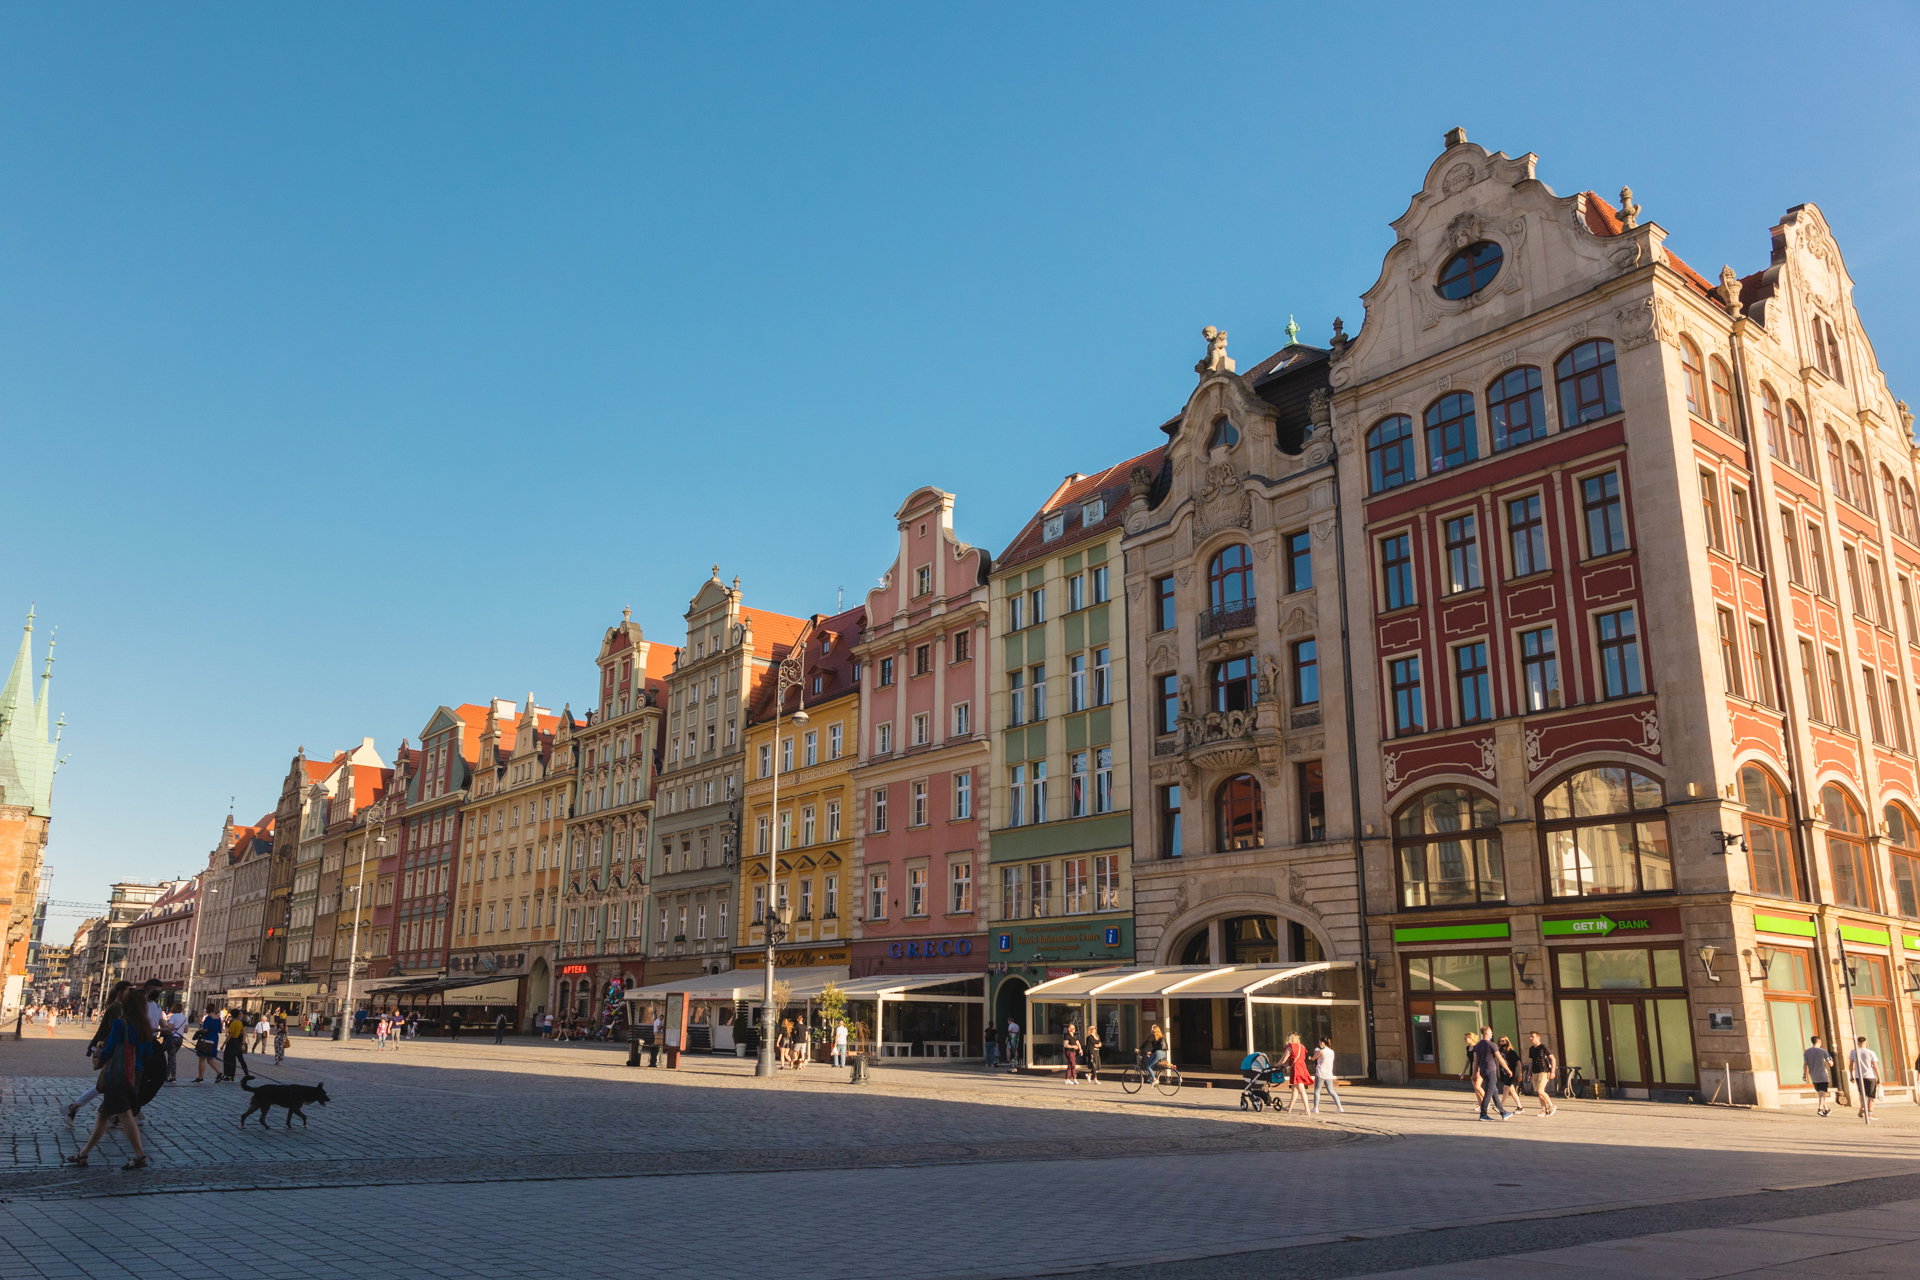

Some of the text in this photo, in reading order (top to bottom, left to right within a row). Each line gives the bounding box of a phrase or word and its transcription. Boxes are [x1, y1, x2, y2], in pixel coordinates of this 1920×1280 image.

[1618, 920, 1649, 930] BANK
[1040, 935, 1078, 944] Information
[889, 939, 972, 958] GRECO
[563, 965, 587, 974] APTEKA
